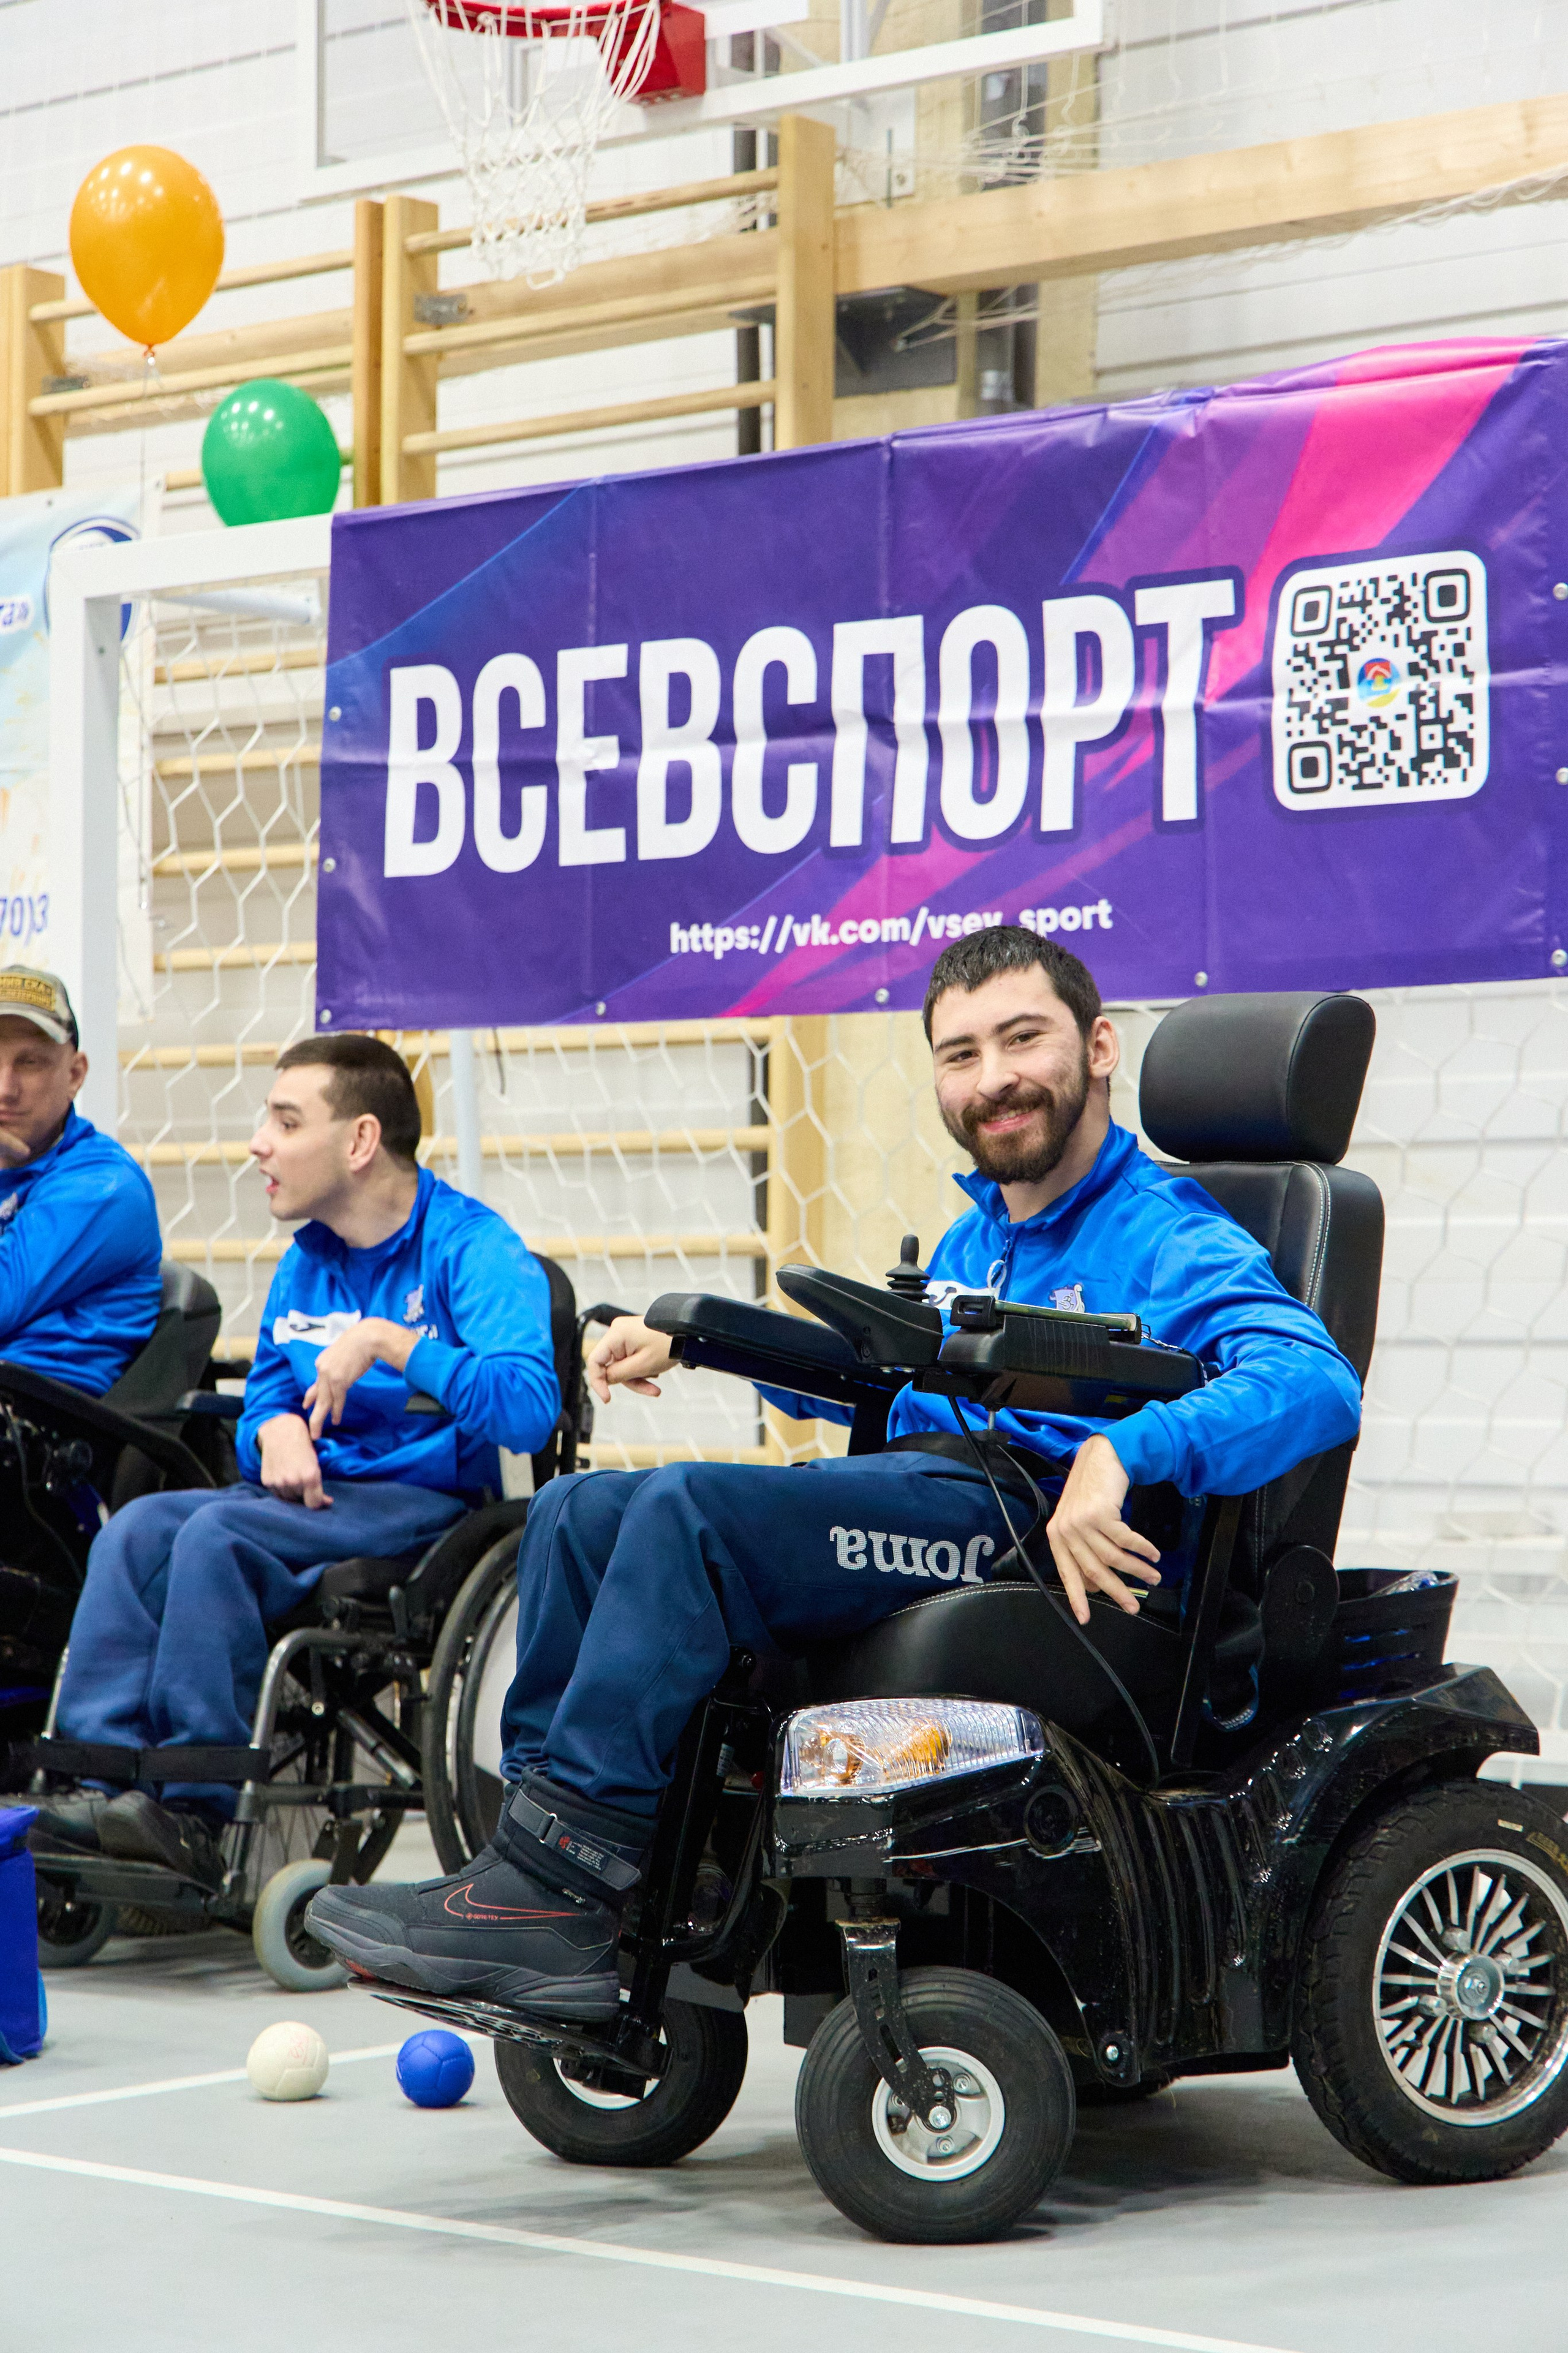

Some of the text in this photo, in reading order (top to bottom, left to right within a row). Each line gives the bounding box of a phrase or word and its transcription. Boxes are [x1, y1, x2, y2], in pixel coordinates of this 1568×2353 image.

[383, 578, 1237, 878] ВСЕВСПОРТ
[670, 898, 1114, 960] https://vk.com/vsevsport
[829, 1525, 995, 1584] Joma
